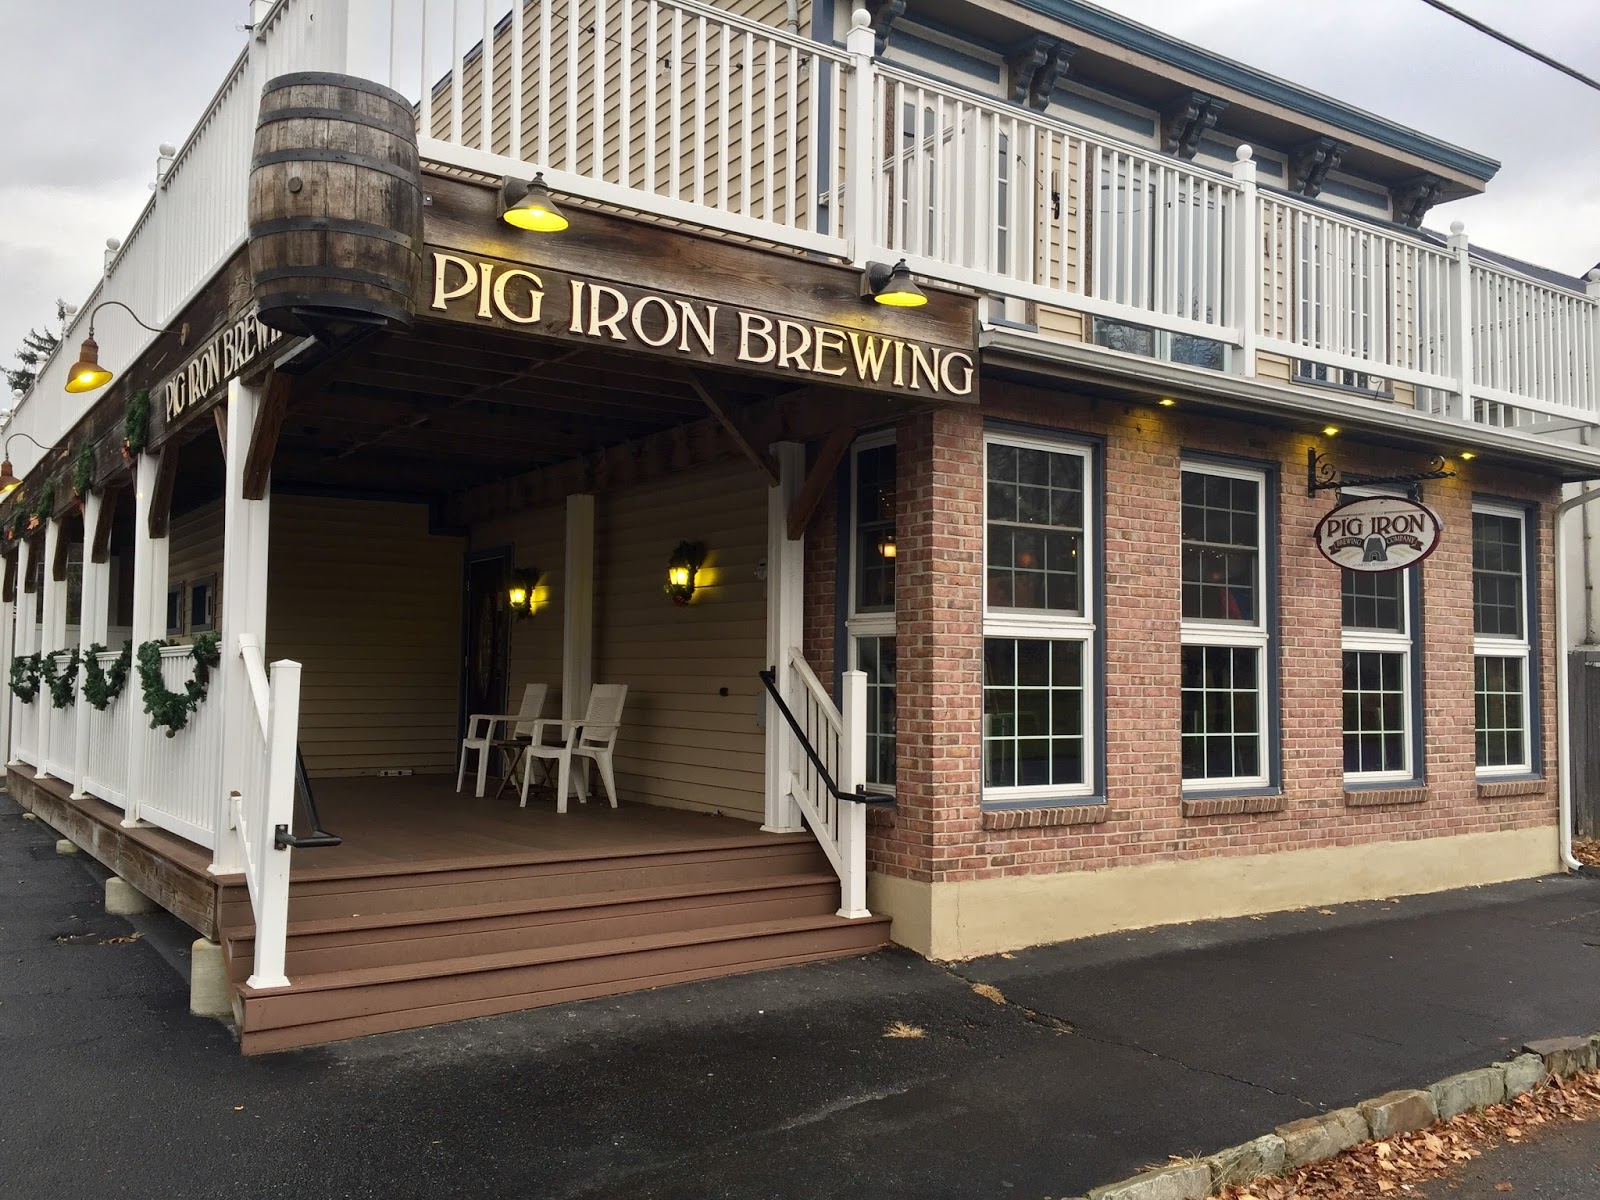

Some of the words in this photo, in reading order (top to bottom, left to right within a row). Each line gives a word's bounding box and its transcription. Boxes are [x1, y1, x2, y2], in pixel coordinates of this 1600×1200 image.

[431, 252, 545, 325] PIG
[568, 279, 718, 357] IRON
[736, 311, 975, 396] BREWING
[165, 371, 186, 423] PIG
[187, 337, 221, 407] IRON
[223, 309, 283, 380] BREW
[1327, 518, 1363, 537] PIG
[1371, 513, 1426, 535] IRON
[1337, 537, 1362, 546] BREWING
[1386, 535, 1416, 544] COMPANY
